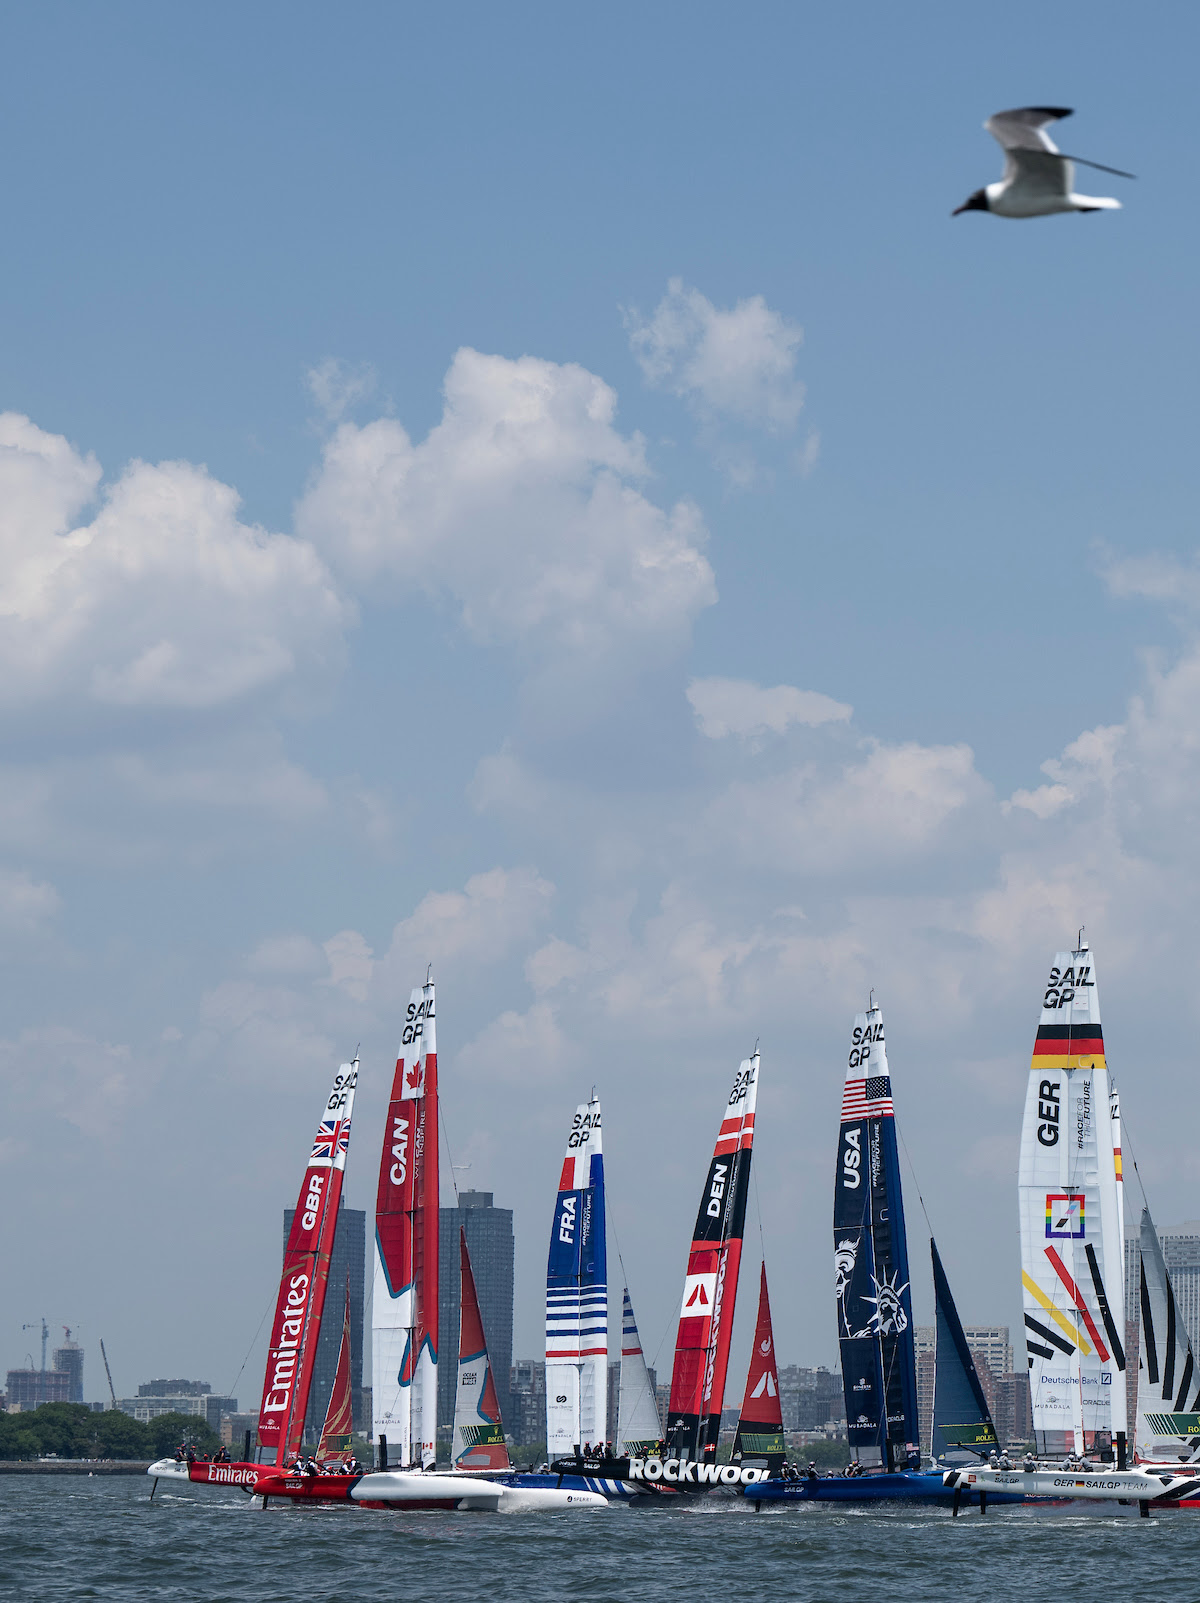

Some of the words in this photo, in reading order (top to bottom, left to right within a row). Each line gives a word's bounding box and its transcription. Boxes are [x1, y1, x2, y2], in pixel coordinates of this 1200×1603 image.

[1048, 967, 1094, 987] SAIL
[1043, 988, 1075, 1008] GP
[405, 1000, 435, 1022] SAIL
[402, 1023, 424, 1044] GP
[852, 1023, 885, 1046] SAIL
[848, 1047, 871, 1068] GP
[572, 1113, 602, 1129] SAIL
[1037, 1079, 1061, 1147] GER
[568, 1131, 590, 1148] GP
[389, 1117, 410, 1186] CAN
[843, 1127, 861, 1189] USA
[706, 1163, 728, 1218] DEN
[301, 1174, 324, 1231] GBR
[559, 1196, 577, 1244] FRA
[263, 1273, 309, 1414] Emirates
[1042, 1375, 1079, 1385] Deutsche
[1081, 1376, 1098, 1385] Bank
[208, 1464, 259, 1485] Emirates
[1053, 1478, 1075, 1487] GER
[1085, 1480, 1121, 1489] SAILGP
[1122, 1482, 1148, 1491] TEAM
